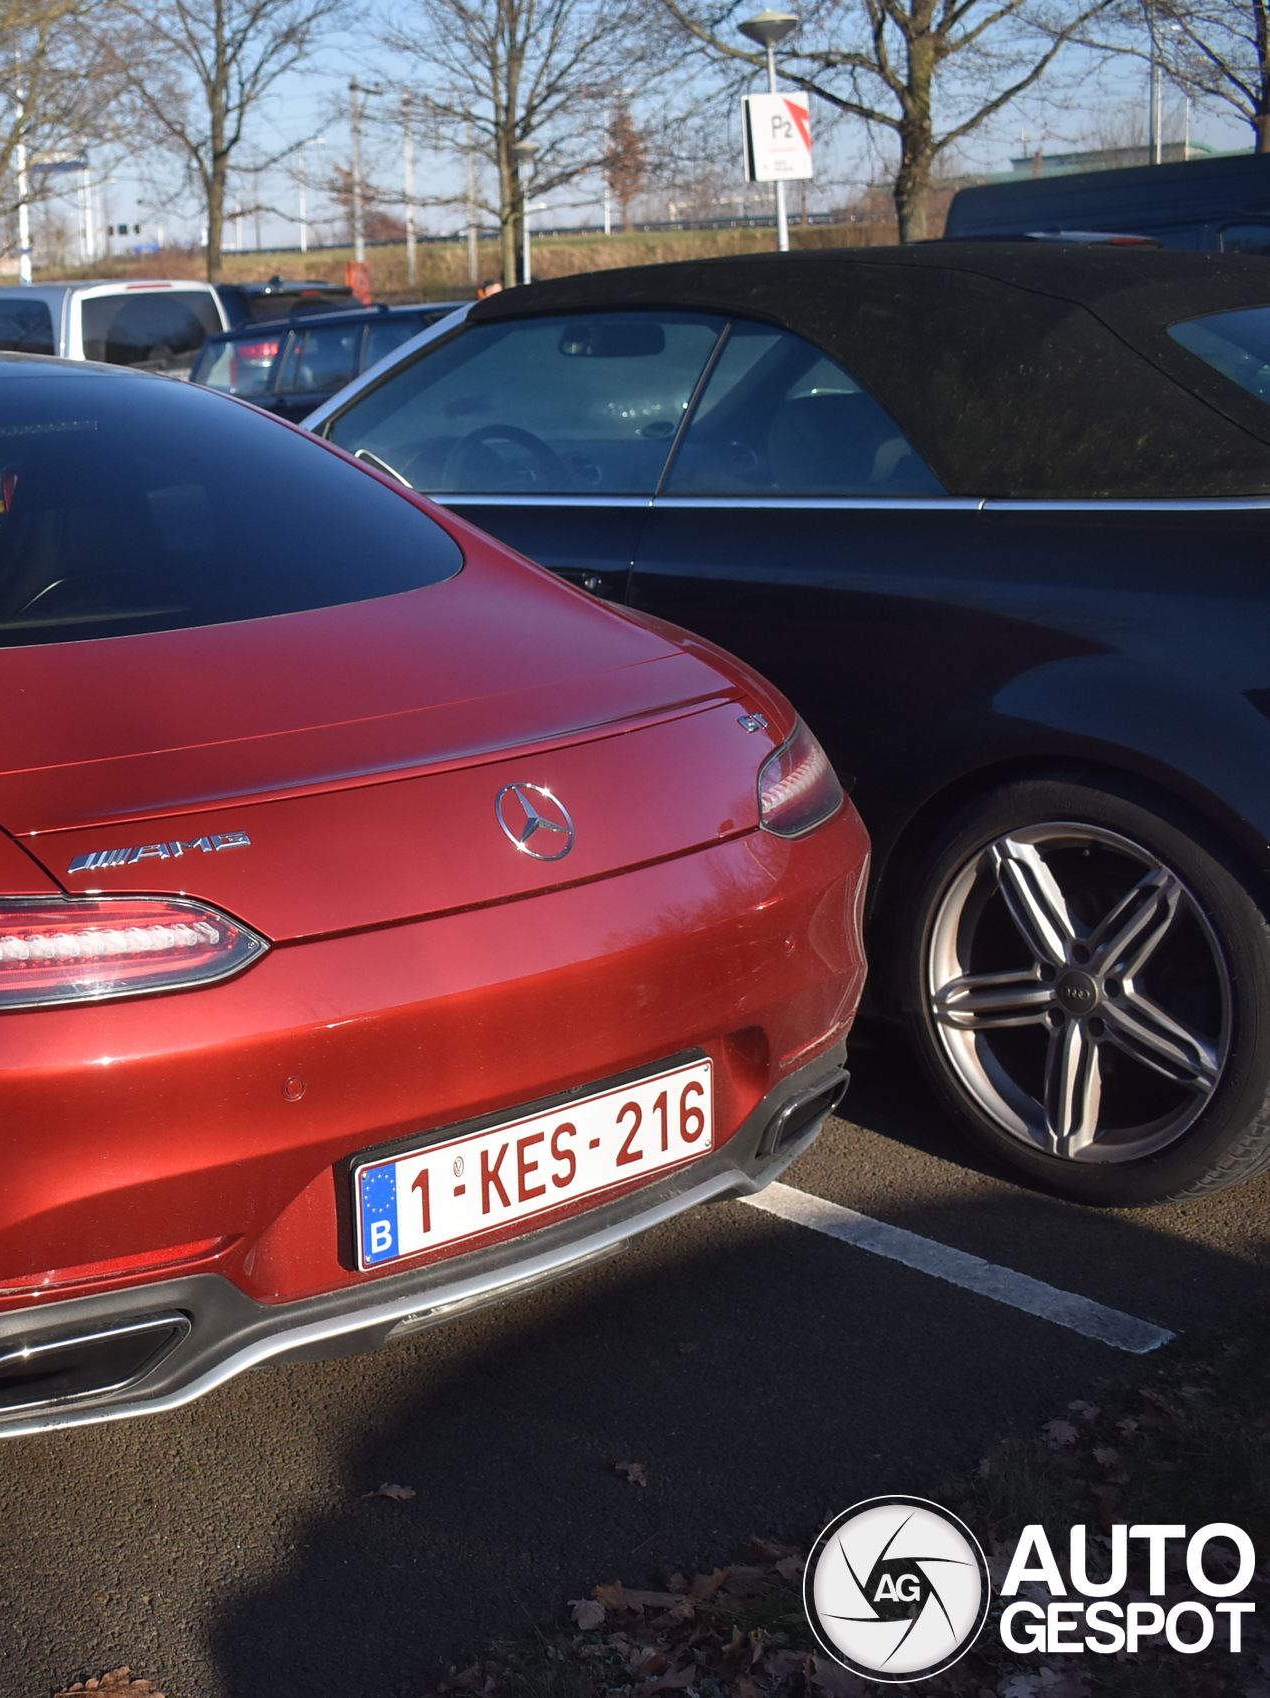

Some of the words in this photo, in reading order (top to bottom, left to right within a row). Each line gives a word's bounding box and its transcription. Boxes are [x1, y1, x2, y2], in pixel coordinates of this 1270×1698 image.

[771, 115, 792, 138] P2
[737, 712, 768, 733] GT
[129, 831, 251, 864] AMG
[411, 1081, 705, 1233] 1-KES-216
[370, 1219, 392, 1254] B
